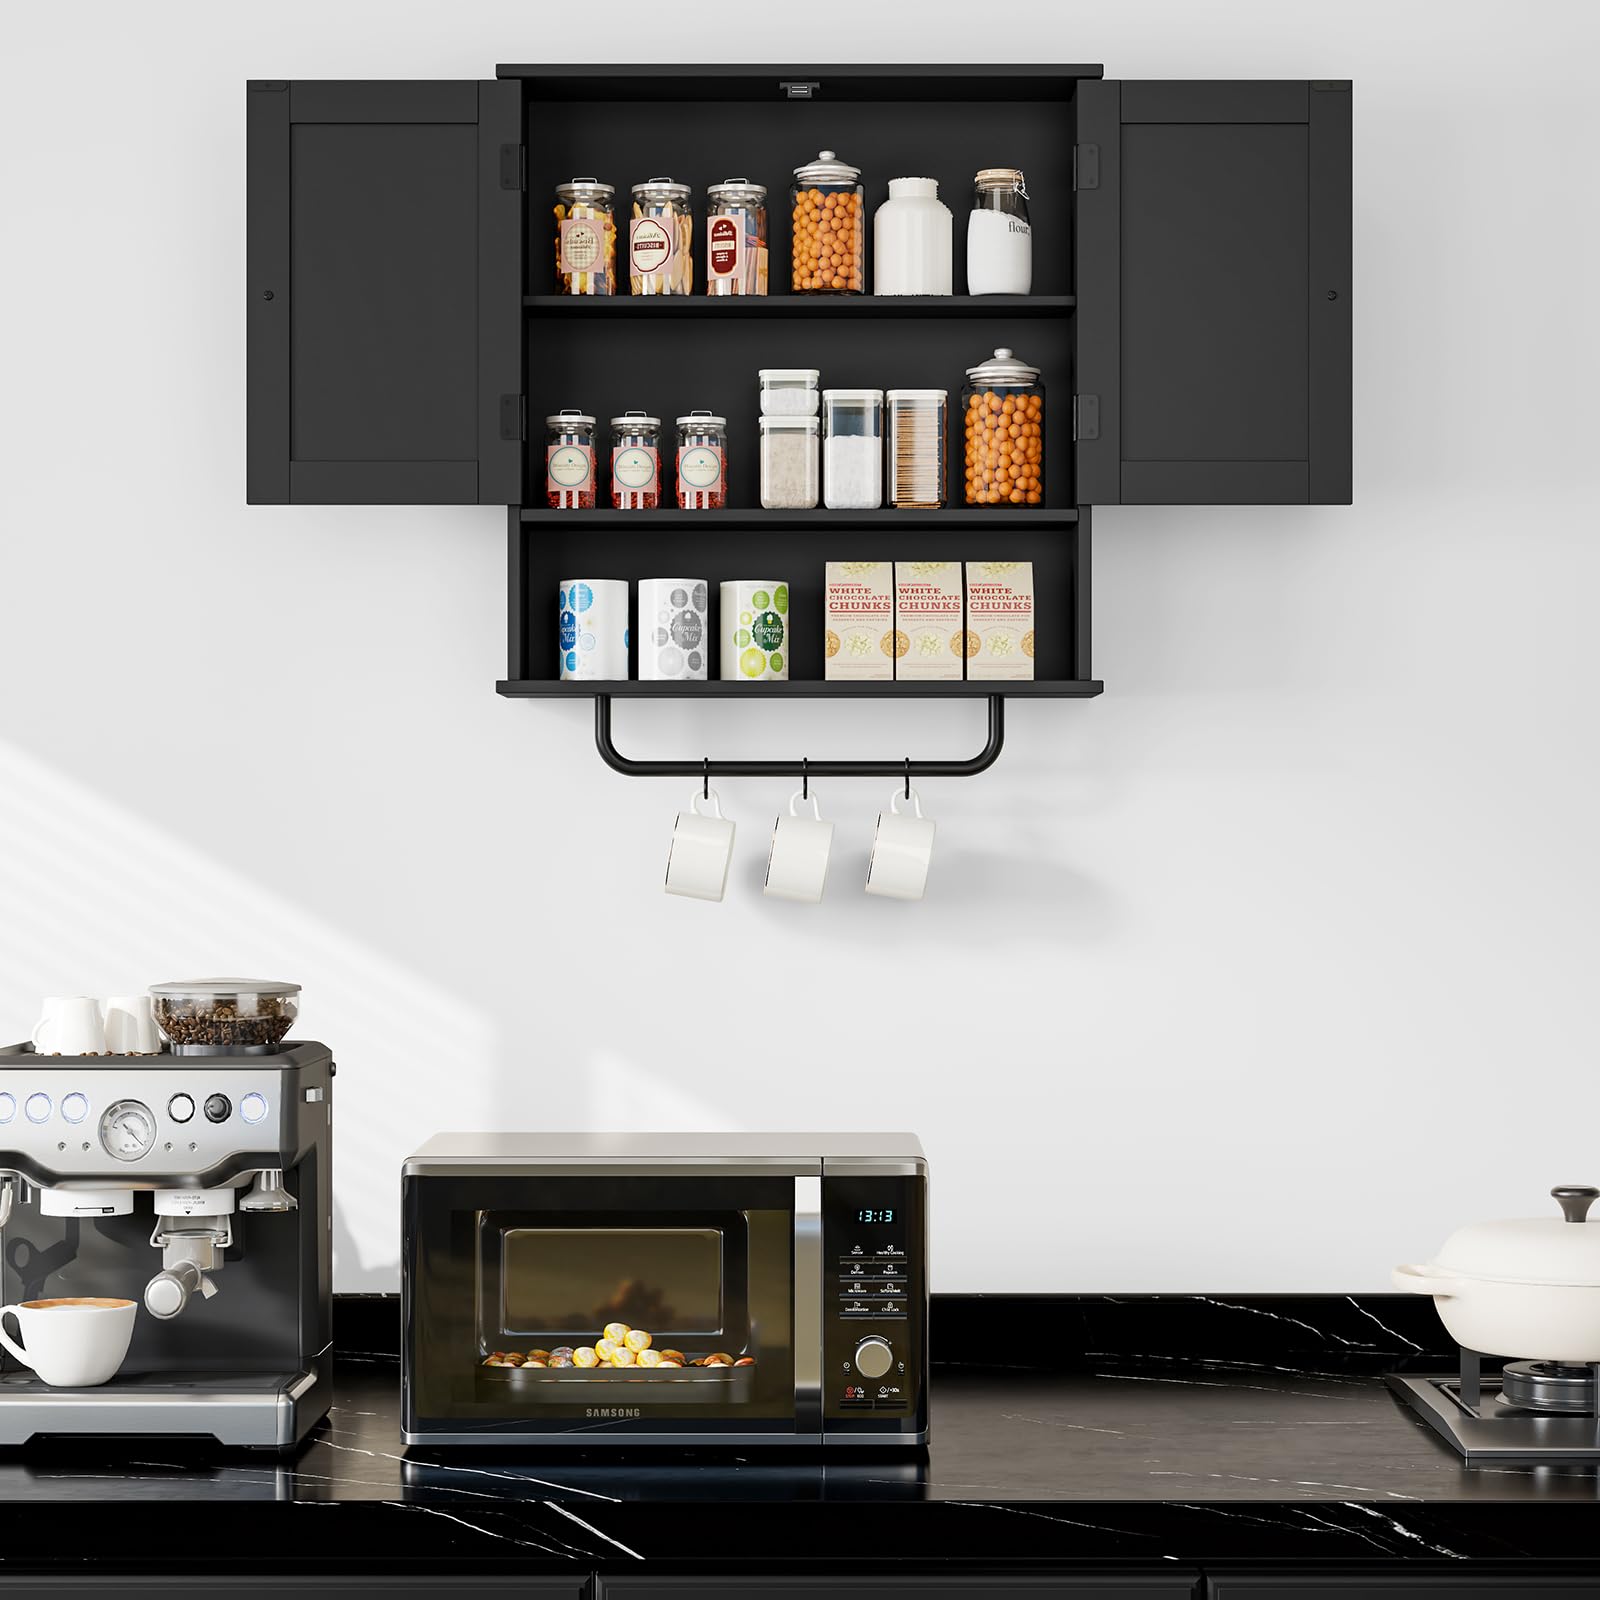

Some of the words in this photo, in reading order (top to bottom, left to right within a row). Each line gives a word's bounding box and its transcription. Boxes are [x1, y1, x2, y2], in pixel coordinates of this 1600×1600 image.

[672, 624, 702, 633] Cupcake
[754, 624, 782, 634] Cupcake
[683, 632, 698, 642] Mix
[764, 633, 780, 643] Mix
[859, 1210, 892, 1222] 13:13
